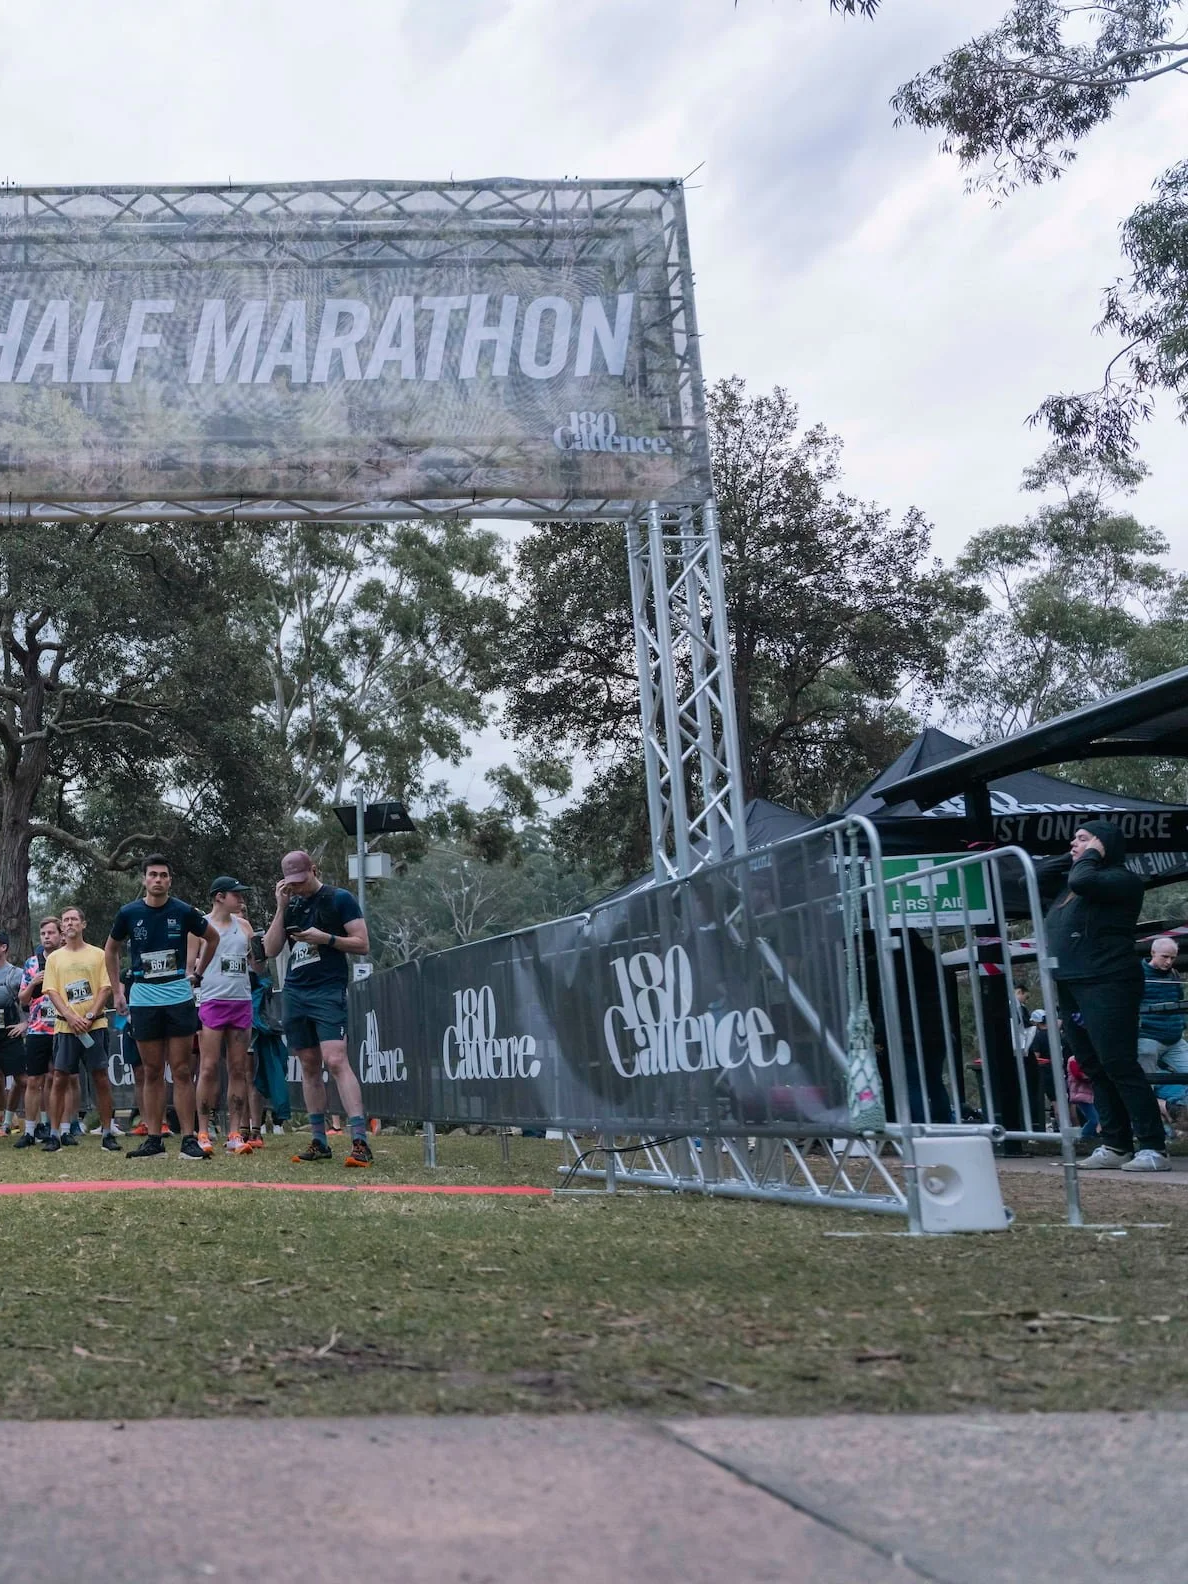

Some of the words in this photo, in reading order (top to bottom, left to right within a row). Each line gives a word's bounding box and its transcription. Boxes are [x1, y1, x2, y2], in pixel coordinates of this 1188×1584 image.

[186, 292, 636, 384] MARATHON
[151, 959, 167, 971] 667
[229, 960, 243, 971] 891
[73, 986, 87, 998] 575
[609, 945, 693, 1030] 180
[453, 985, 497, 1044] 180
